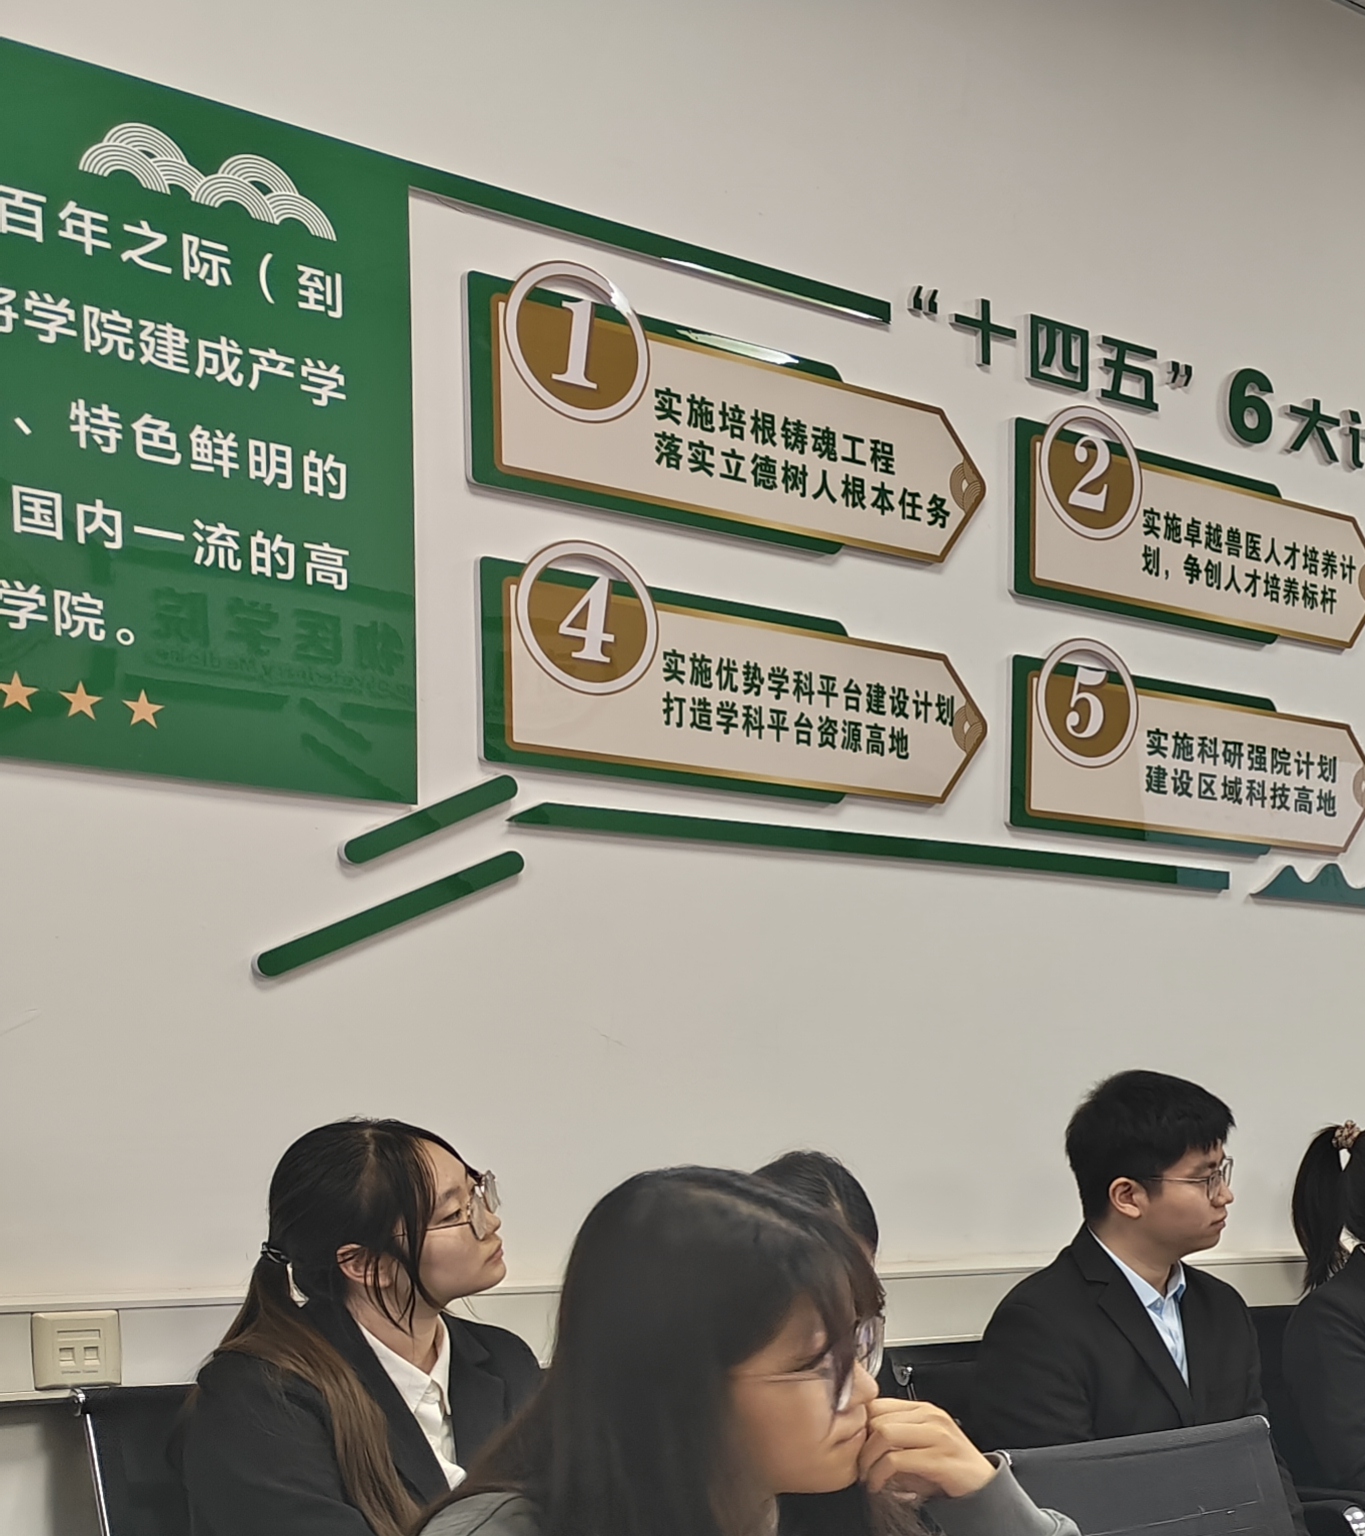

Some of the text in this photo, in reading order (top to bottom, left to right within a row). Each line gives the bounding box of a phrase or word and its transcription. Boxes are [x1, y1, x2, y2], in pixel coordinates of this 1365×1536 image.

[551, 299, 598, 390] 1
[654, 387, 896, 476] 实施培根铸魂工程
[654, 431, 951, 529] 落实立德树人根本任务
[1068, 436, 1112, 512] 2
[12, 484, 349, 591] 国内一流的高
[1142, 507, 1356, 585] 实施卓越兽医人才培养计
[1141, 545, 1338, 615] 划，争创人才培养标杆
[558, 576, 615, 664] 4
[662, 649, 955, 728] 实施优势学科平台建设计划
[1066, 666, 1108, 739] 5
[662, 696, 910, 760] 打造学科平台资源高地
[1146, 728, 1338, 784] 实施科研强院计划
[1145, 765, 1338, 818] 建设区域科技高地
